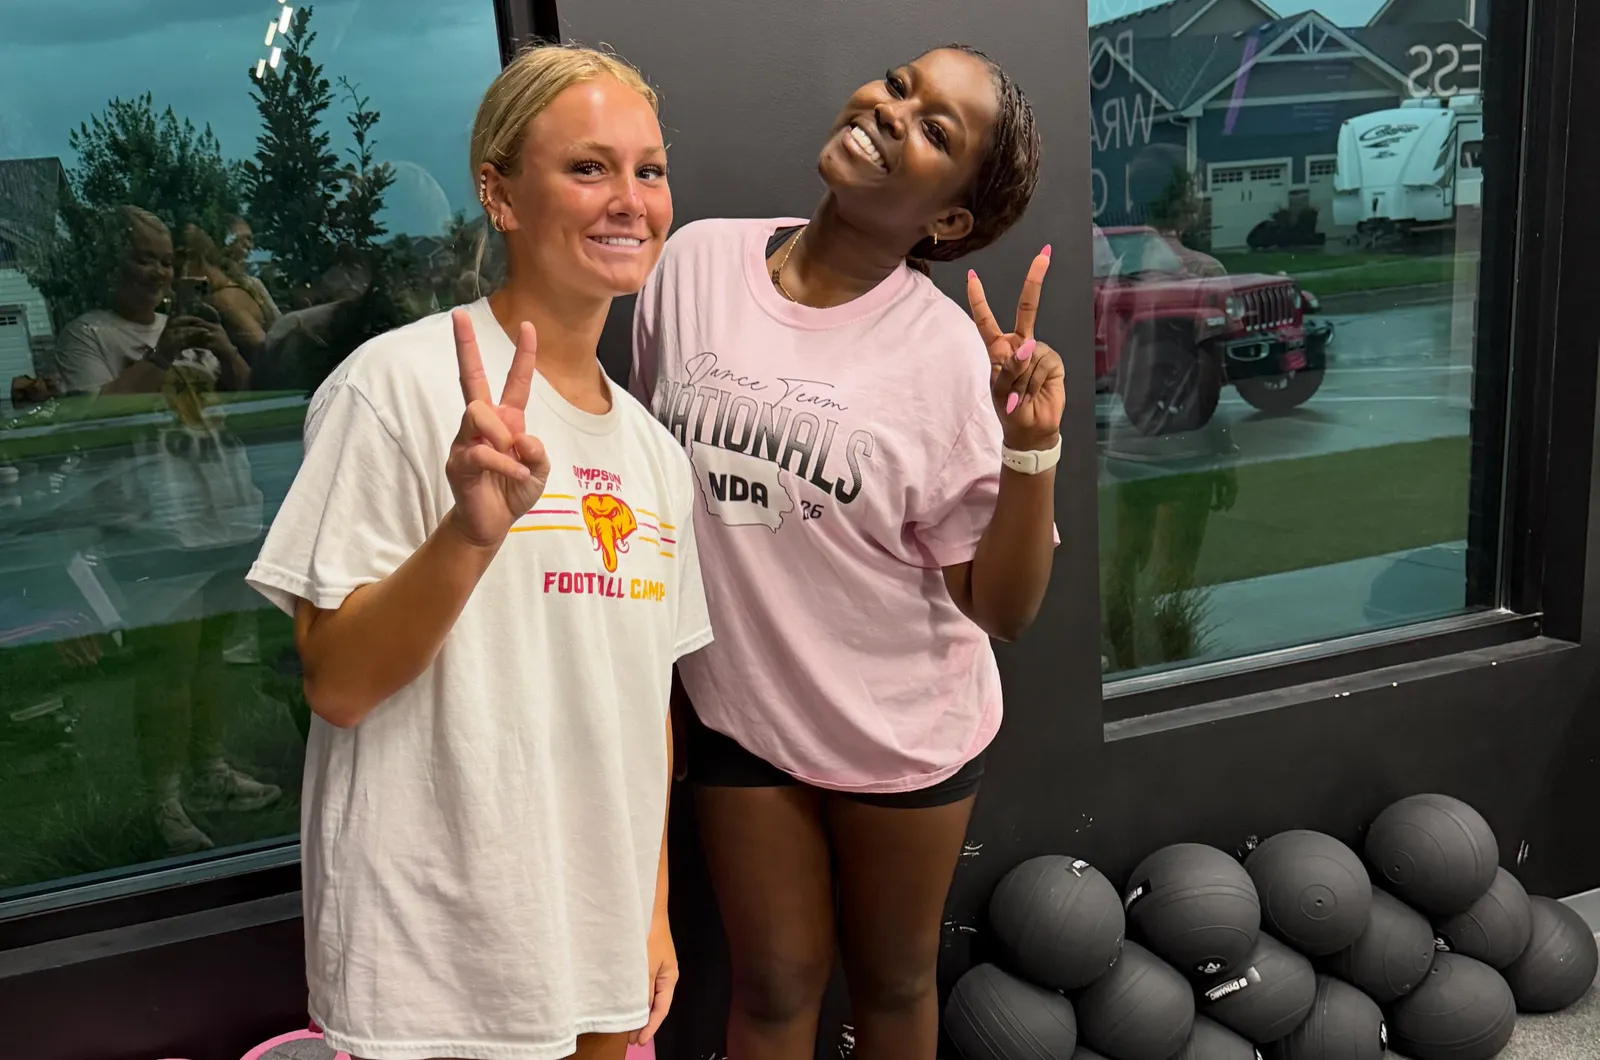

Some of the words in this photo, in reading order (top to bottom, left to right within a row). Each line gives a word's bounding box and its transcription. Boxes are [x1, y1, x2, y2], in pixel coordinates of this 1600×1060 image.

[685, 352, 768, 391] Dance
[771, 377, 849, 412] Team
[659, 380, 874, 505] NATIONALS
[572, 465, 622, 486] SIMPSON
[708, 471, 769, 509] NDA
[630, 578, 666, 602] CAMP
